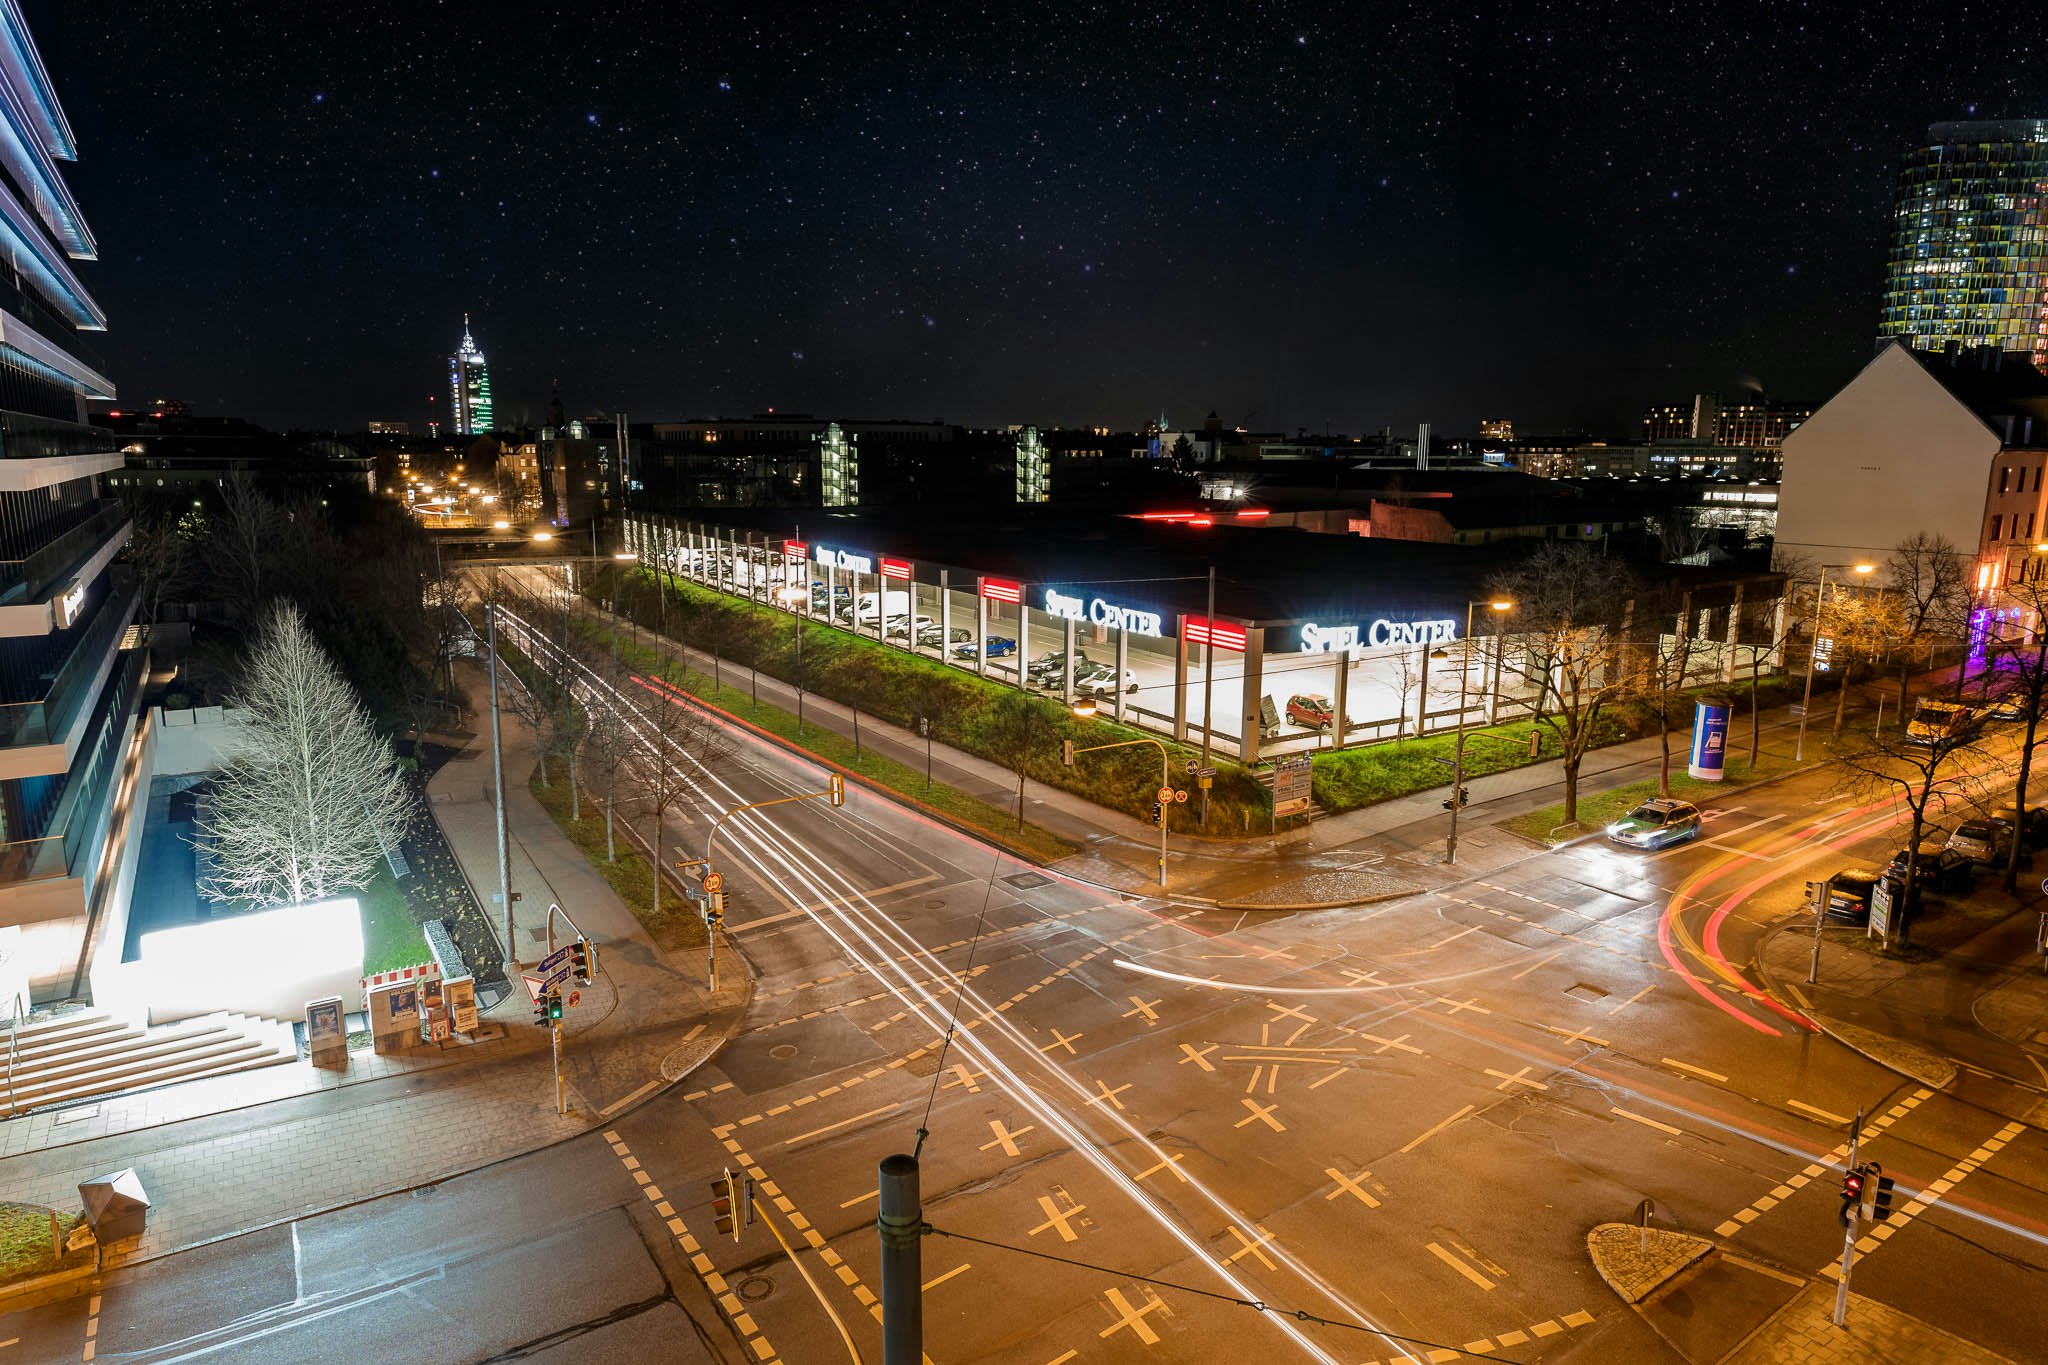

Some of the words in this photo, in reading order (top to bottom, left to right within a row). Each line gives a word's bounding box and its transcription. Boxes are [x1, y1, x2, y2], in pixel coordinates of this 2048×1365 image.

[1046, 589, 1087, 621] SPIEL
[1090, 598, 1162, 638] CENTER
[1301, 623, 1365, 655] SPIEL
[1369, 619, 1456, 648] CENTER
